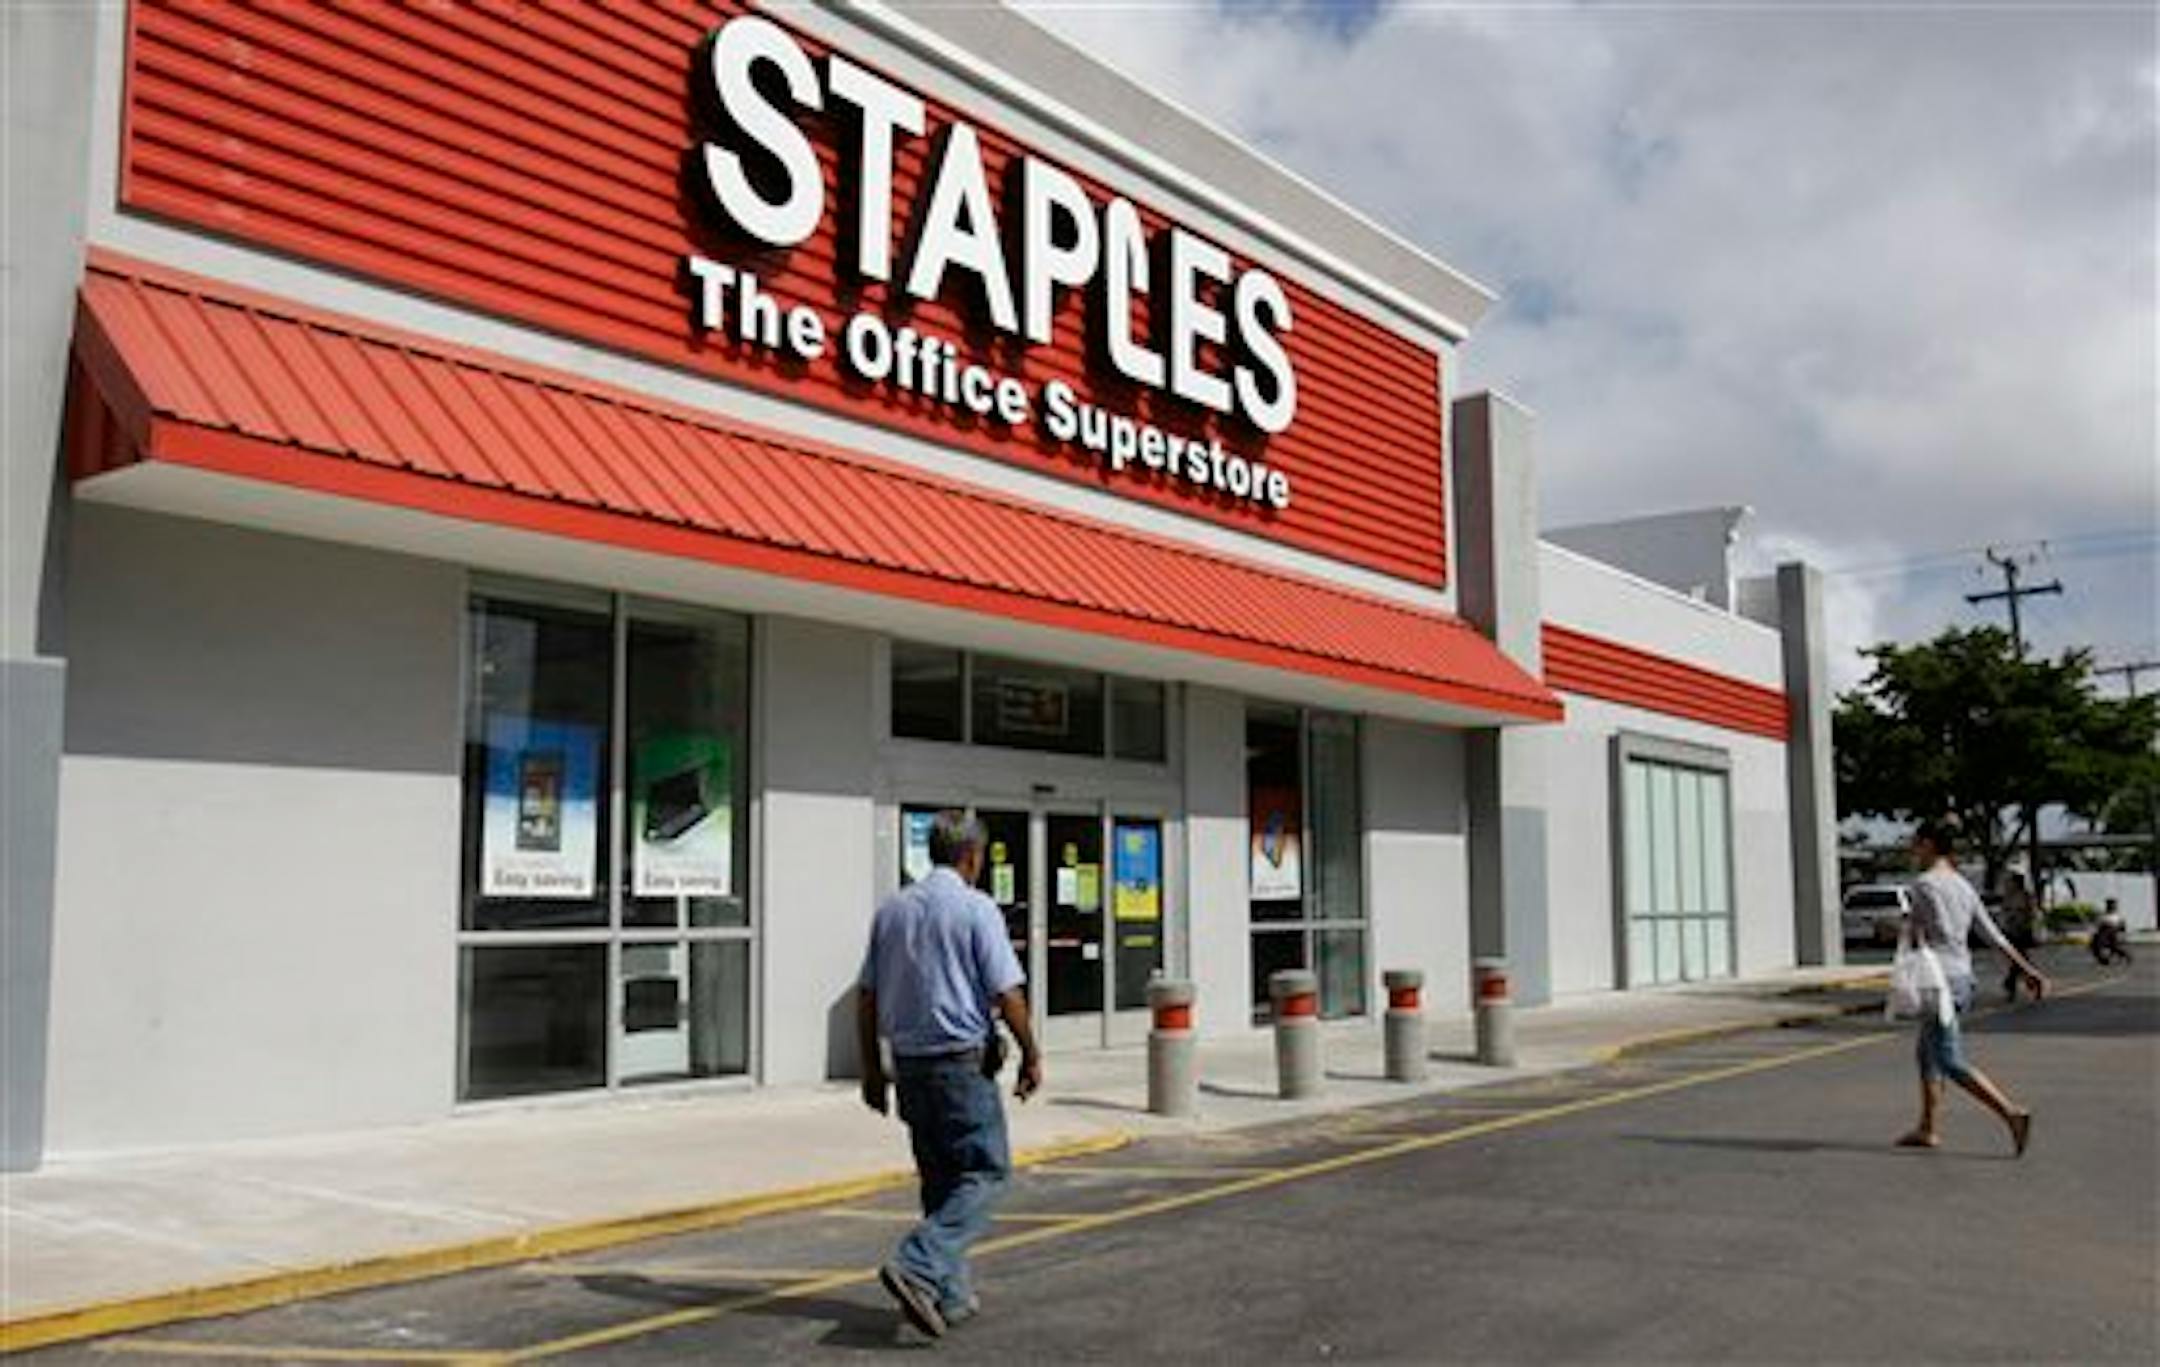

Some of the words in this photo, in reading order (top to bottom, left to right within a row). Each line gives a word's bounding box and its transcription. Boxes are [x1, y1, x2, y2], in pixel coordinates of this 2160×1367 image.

[690, 257, 824, 360] The
[846, 314, 1027, 423] Office
[1045, 380, 1289, 507] Superstore
[705, 15, 1297, 434] STAPLES
